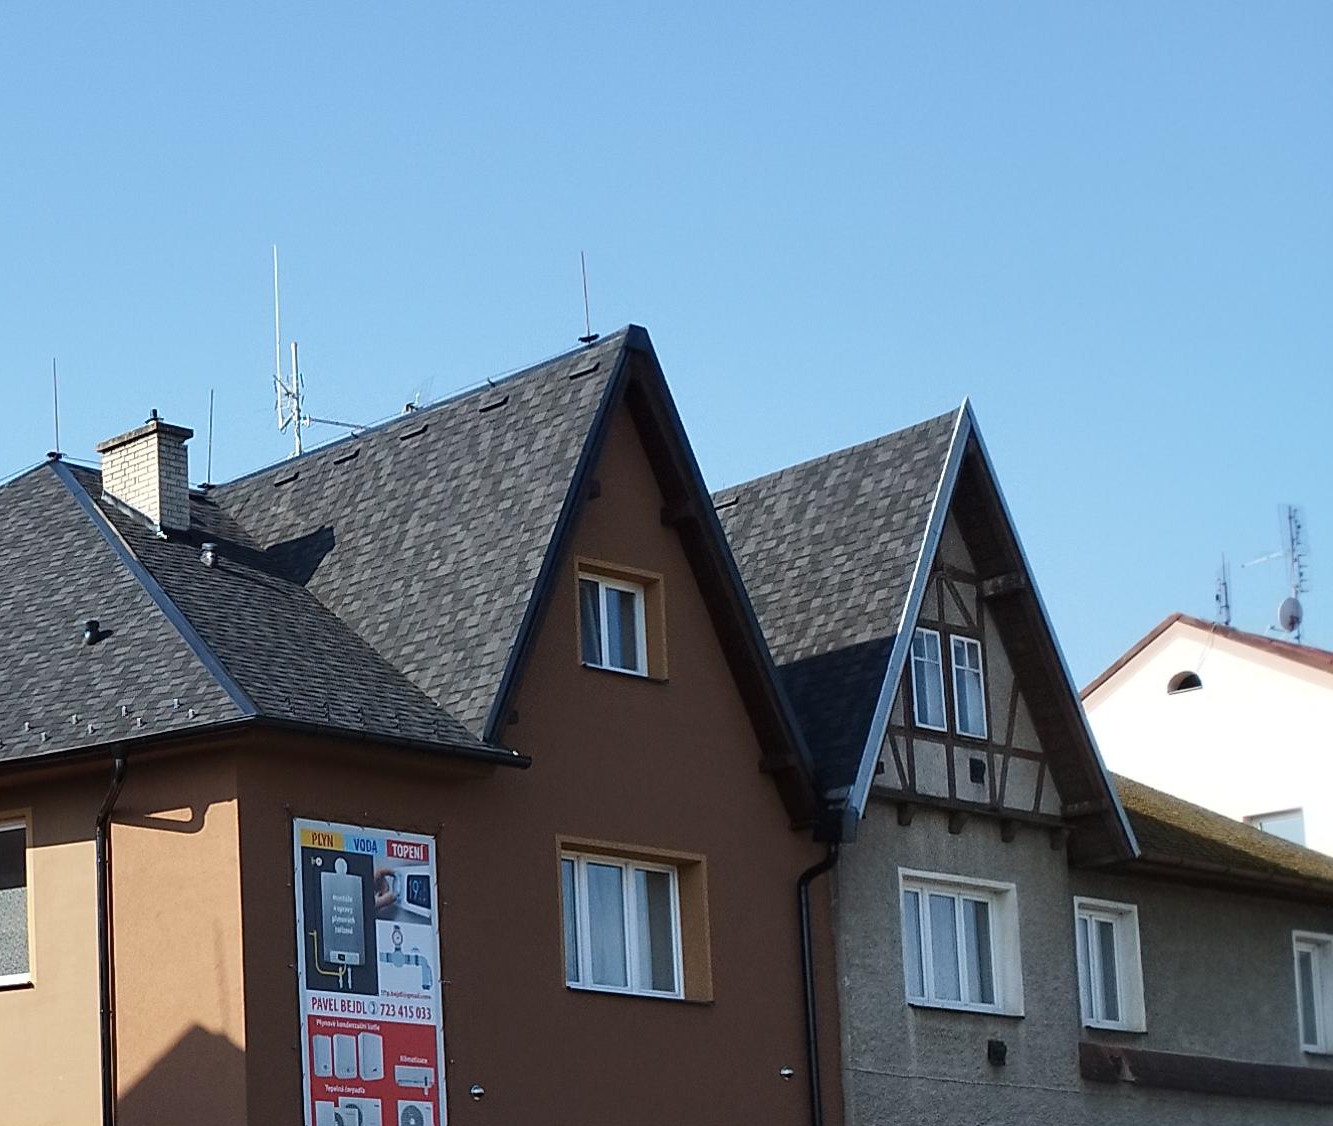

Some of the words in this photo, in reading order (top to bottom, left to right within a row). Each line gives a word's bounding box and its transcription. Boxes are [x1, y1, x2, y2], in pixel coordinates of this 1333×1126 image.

[312, 832, 334, 848] PLYN
[353, 838, 378, 853] VODA
[392, 843, 425, 860] TOPENÍ
[311, 996, 339, 1012] PAVEL
[340, 999, 367, 1015] BEJDL
[380, 1003, 395, 1017] 723
[398, 1005, 414, 1018] 415
[416, 1006, 432, 1020] 033
